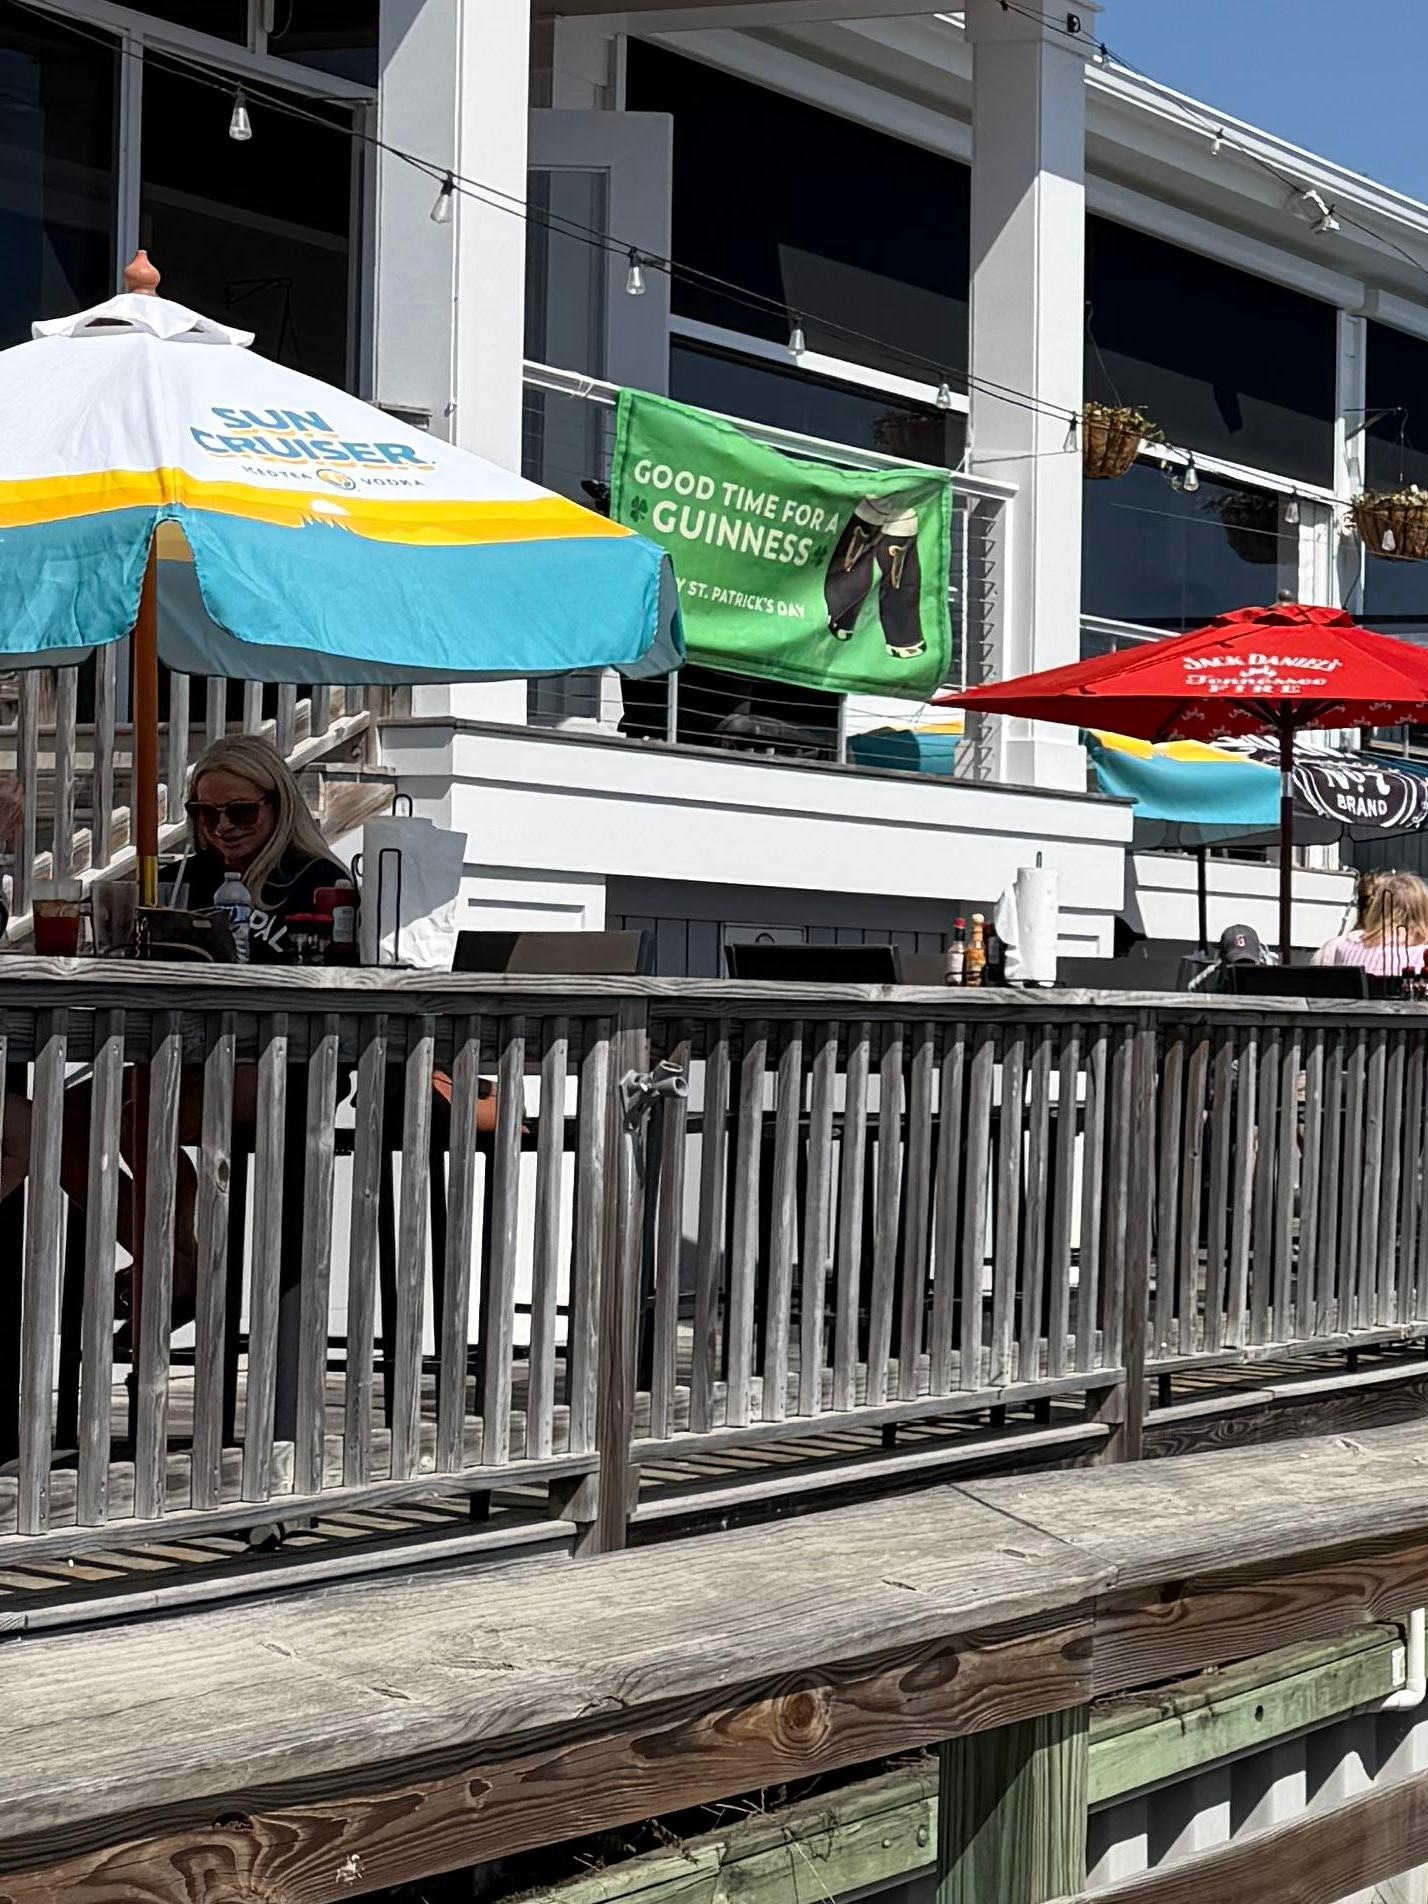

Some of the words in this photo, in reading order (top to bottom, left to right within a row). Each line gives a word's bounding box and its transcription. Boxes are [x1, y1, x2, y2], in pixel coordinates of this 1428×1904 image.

[210, 407, 335, 433] SUN
[190, 426, 430, 466] CRUISER
[360, 477, 426, 487] VODKA
[634, 459, 715, 500] GOOD
[722, 482, 780, 520] TIME
[781, 499, 825, 531] FOR
[825, 512, 839, 535] A
[652, 500, 813, 566] GUINNESS
[688, 581, 708, 598] ST.
[712, 586, 774, 614] PATRICK'S
[777, 602, 806, 619] DAY
[1183, 654, 1245, 671] JACK
[1337, 794, 1388, 817] BRAND
